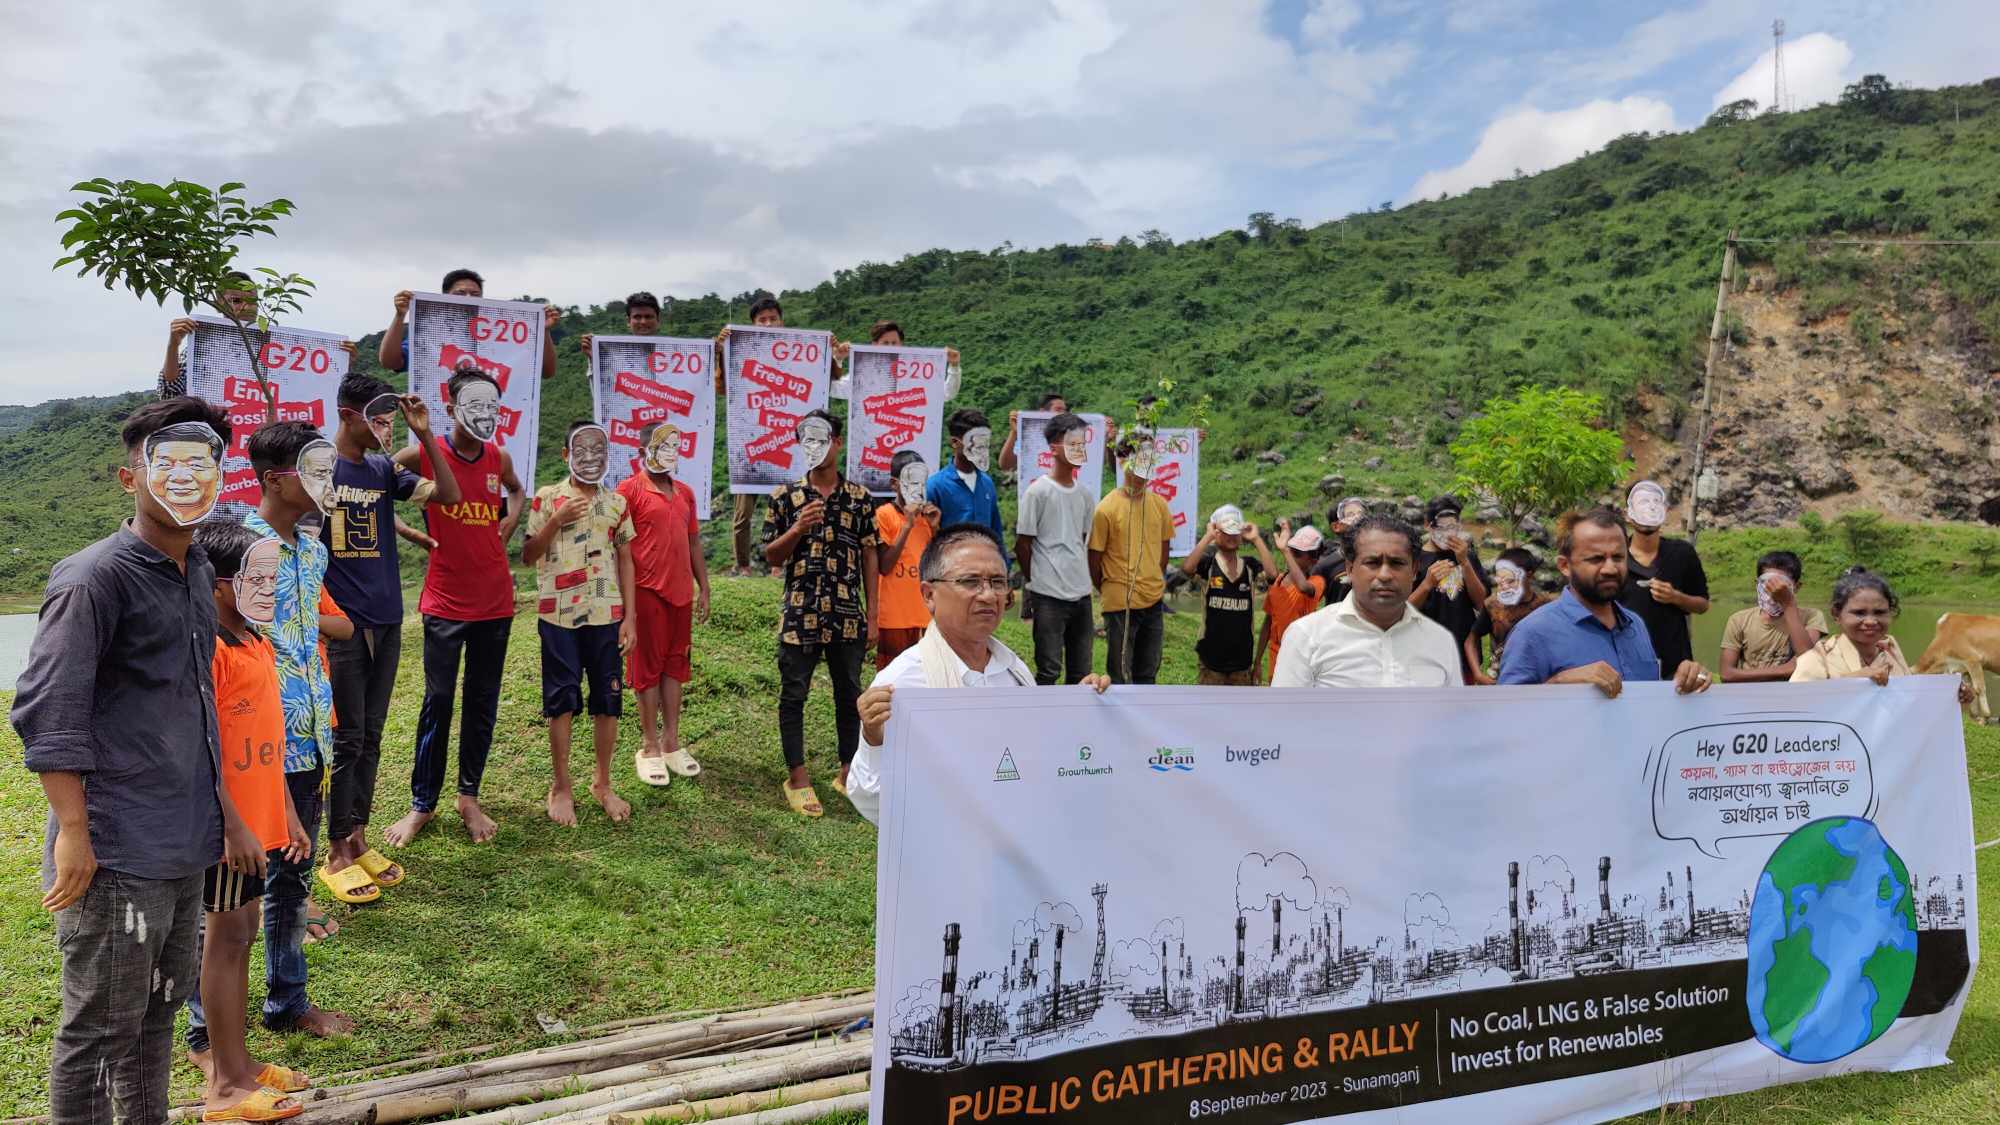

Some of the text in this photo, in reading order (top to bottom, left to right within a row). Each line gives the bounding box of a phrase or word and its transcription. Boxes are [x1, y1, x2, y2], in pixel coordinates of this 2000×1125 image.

[469, 316, 529, 345] G20
[260, 342, 329, 374] G20
[647, 352, 702, 374] G20
[771, 341, 819, 363] G20
[752, 364, 807, 394] Free up
[890, 360, 934, 379] G20
[620, 377, 641, 390] Your
[223, 406, 314, 426] ossi Fuel
[640, 407, 664, 420] are
[767, 415, 794, 428] Free
[883, 432, 909, 448] Our
[1223, 597, 1248, 611] ZEALAND
[1226, 744, 1280, 766] bwged
[1696, 733, 1841, 761] Hey G20 Leaders!
[1148, 753, 1194, 765] clean
[1680, 766, 1718, 780] কয়লা,
[1723, 764, 1747, 777] গ্যাস
[1752, 763, 1763, 776] বা
[1835, 760, 1856, 772] নয়
[1057, 764, 1113, 777] Growthwatch
[1688, 776, 1850, 801] নবায়নযোগ্য জ্বালানিতে
[1720, 800, 1811, 824] অর্থায়ন চাই
[1450, 985, 1729, 1039] No Coal, LNG & False Solution
[1451, 1024, 1664, 1073] Invest for Renewables
[947, 1021, 1420, 1125] PUBLIC GATHERING & RALLY
[1290, 1081, 1327, 1101] 2023
[1343, 1066, 1420, 1092] Sunamganj
